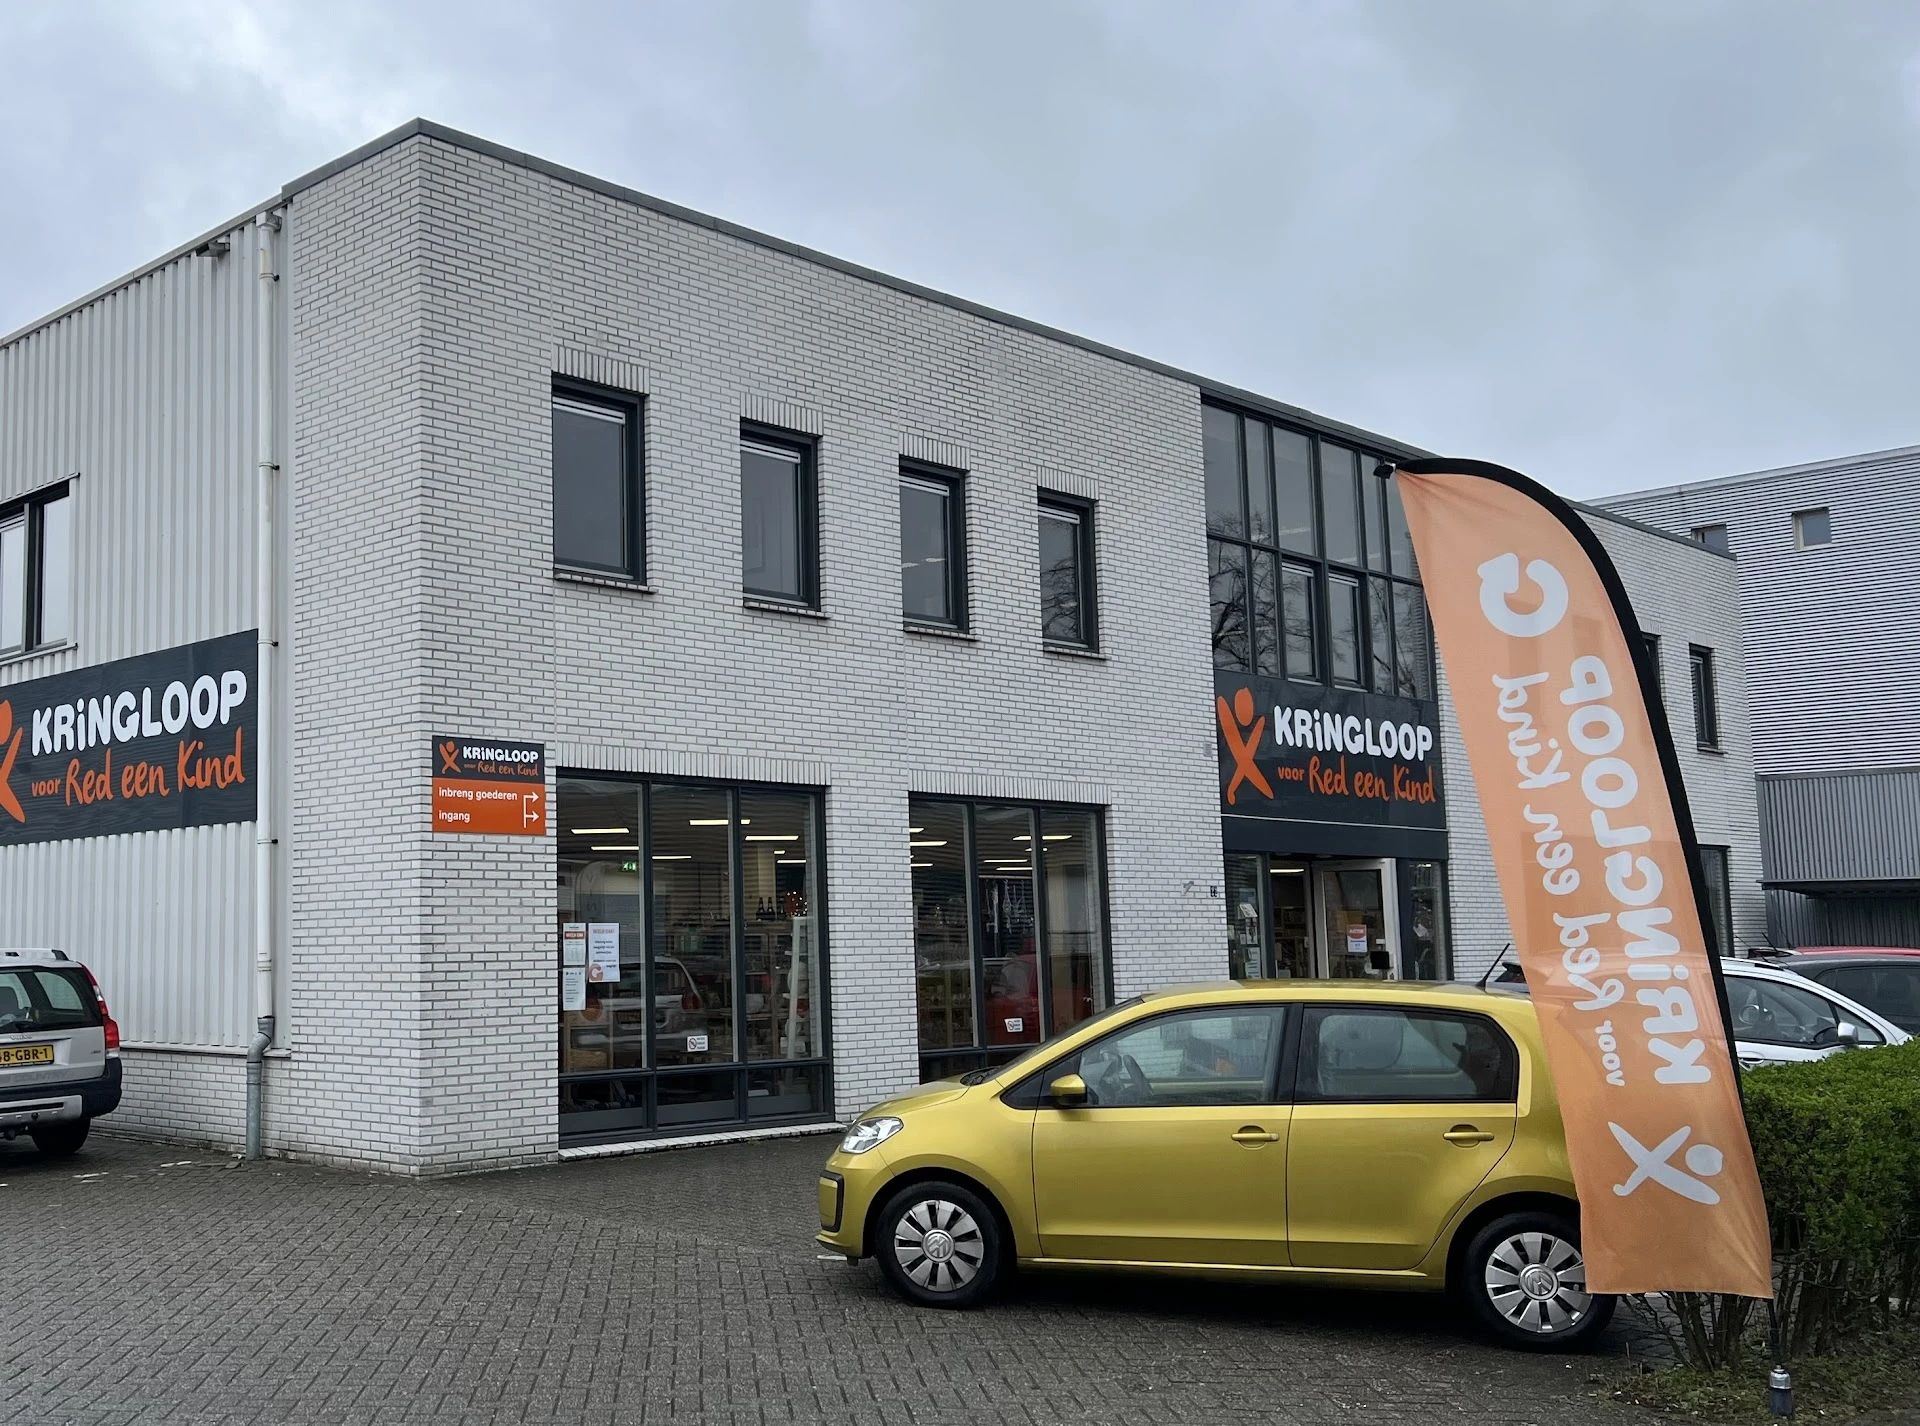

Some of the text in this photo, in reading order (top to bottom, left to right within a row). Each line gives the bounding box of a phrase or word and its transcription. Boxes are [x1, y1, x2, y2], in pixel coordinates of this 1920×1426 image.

[31, 726, 246, 807] voor Red een Kind
[477, 761, 496, 774] Red
[498, 764, 515, 776] een
[517, 763, 539, 776] Kind
[1277, 755, 1437, 805] voor Red een Kind
[438, 787, 518, 801] inbreng goederen
[438, 809, 471, 823] ingang
